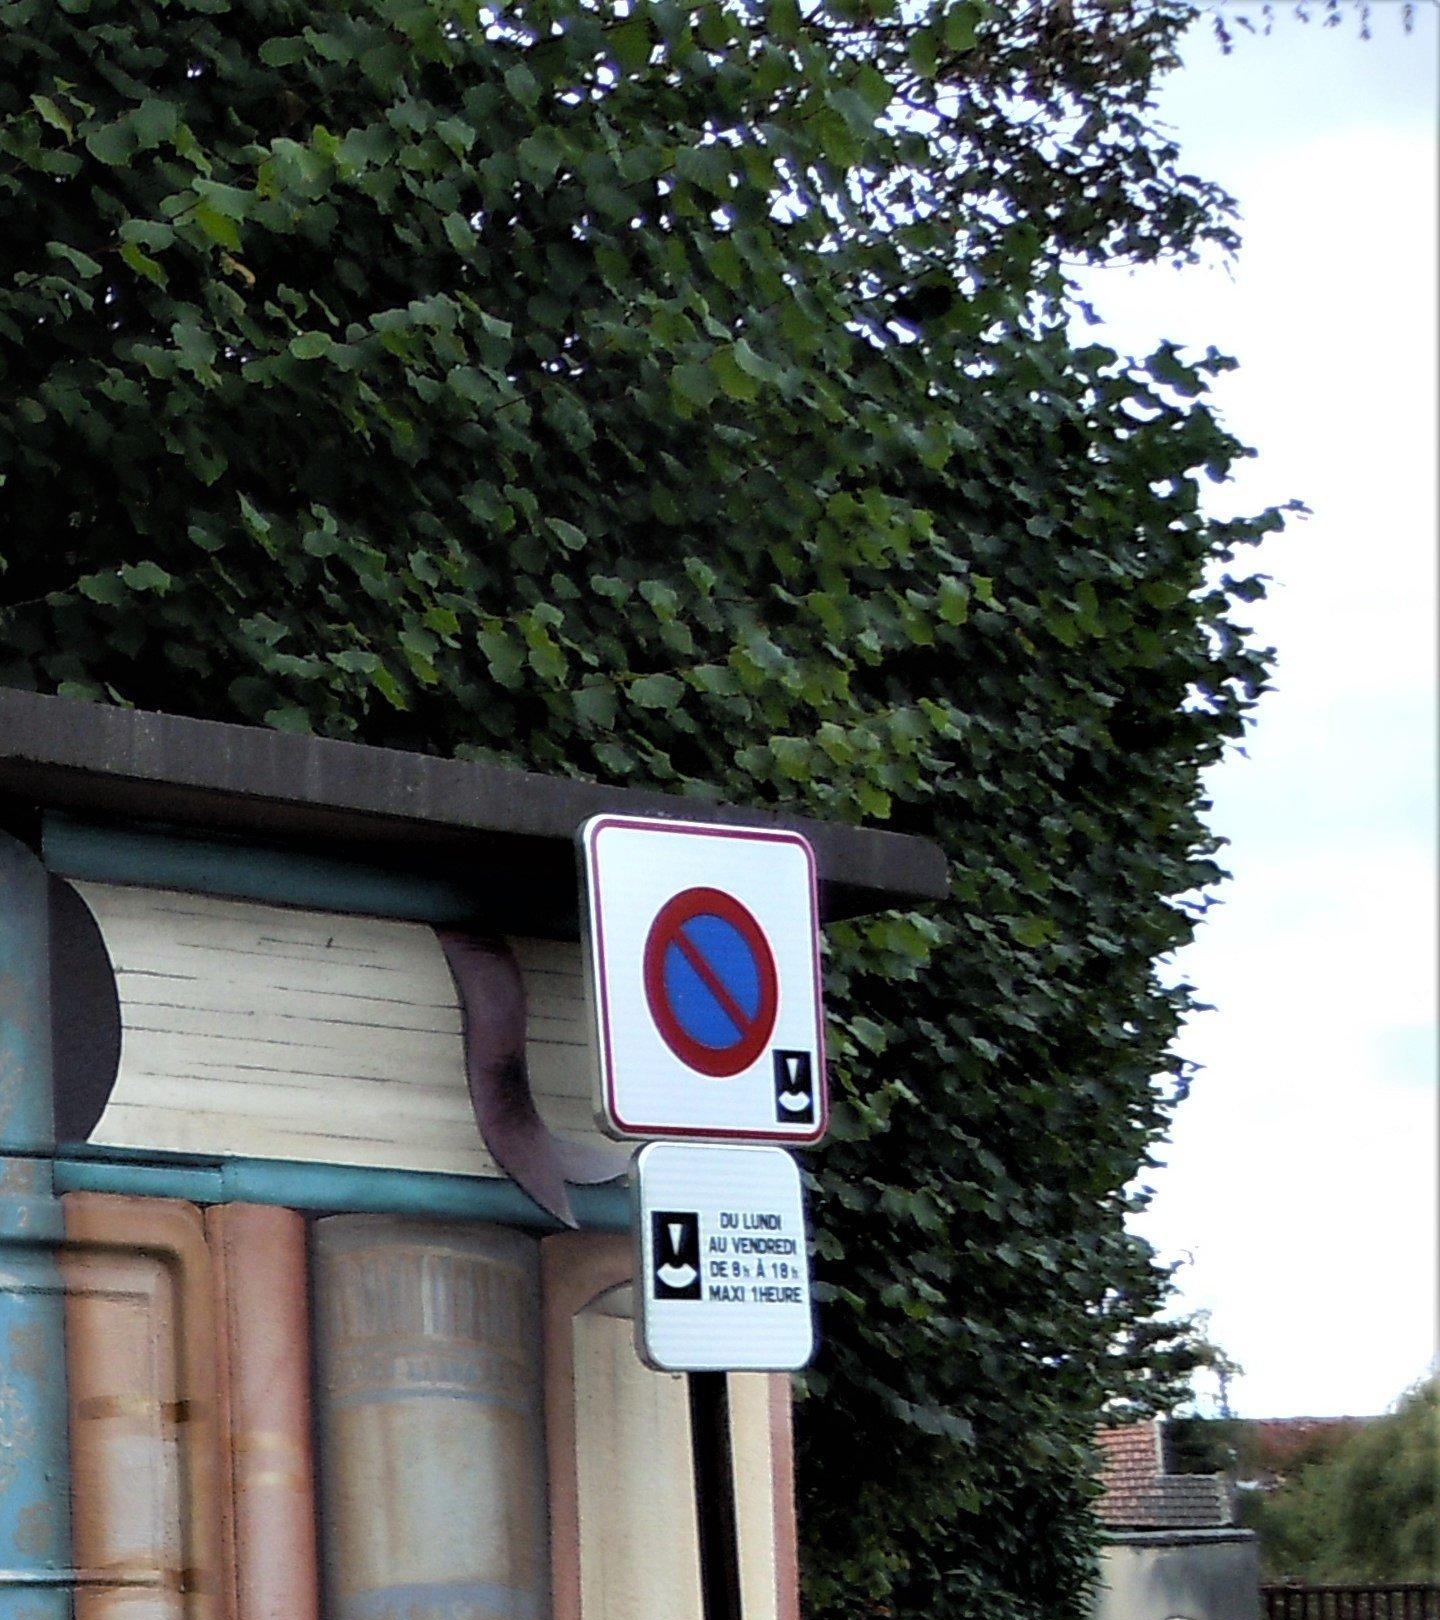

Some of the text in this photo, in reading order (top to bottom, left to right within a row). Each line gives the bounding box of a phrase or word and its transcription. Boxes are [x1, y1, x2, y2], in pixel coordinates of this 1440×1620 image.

[720, 1212, 782, 1231] DU LUNDI
[709, 1236, 797, 1255] AU VENDREDI
[710, 1260, 728, 1278] DE
[756, 1258, 766, 1279] À
[709, 1285, 744, 1301] MAXI
